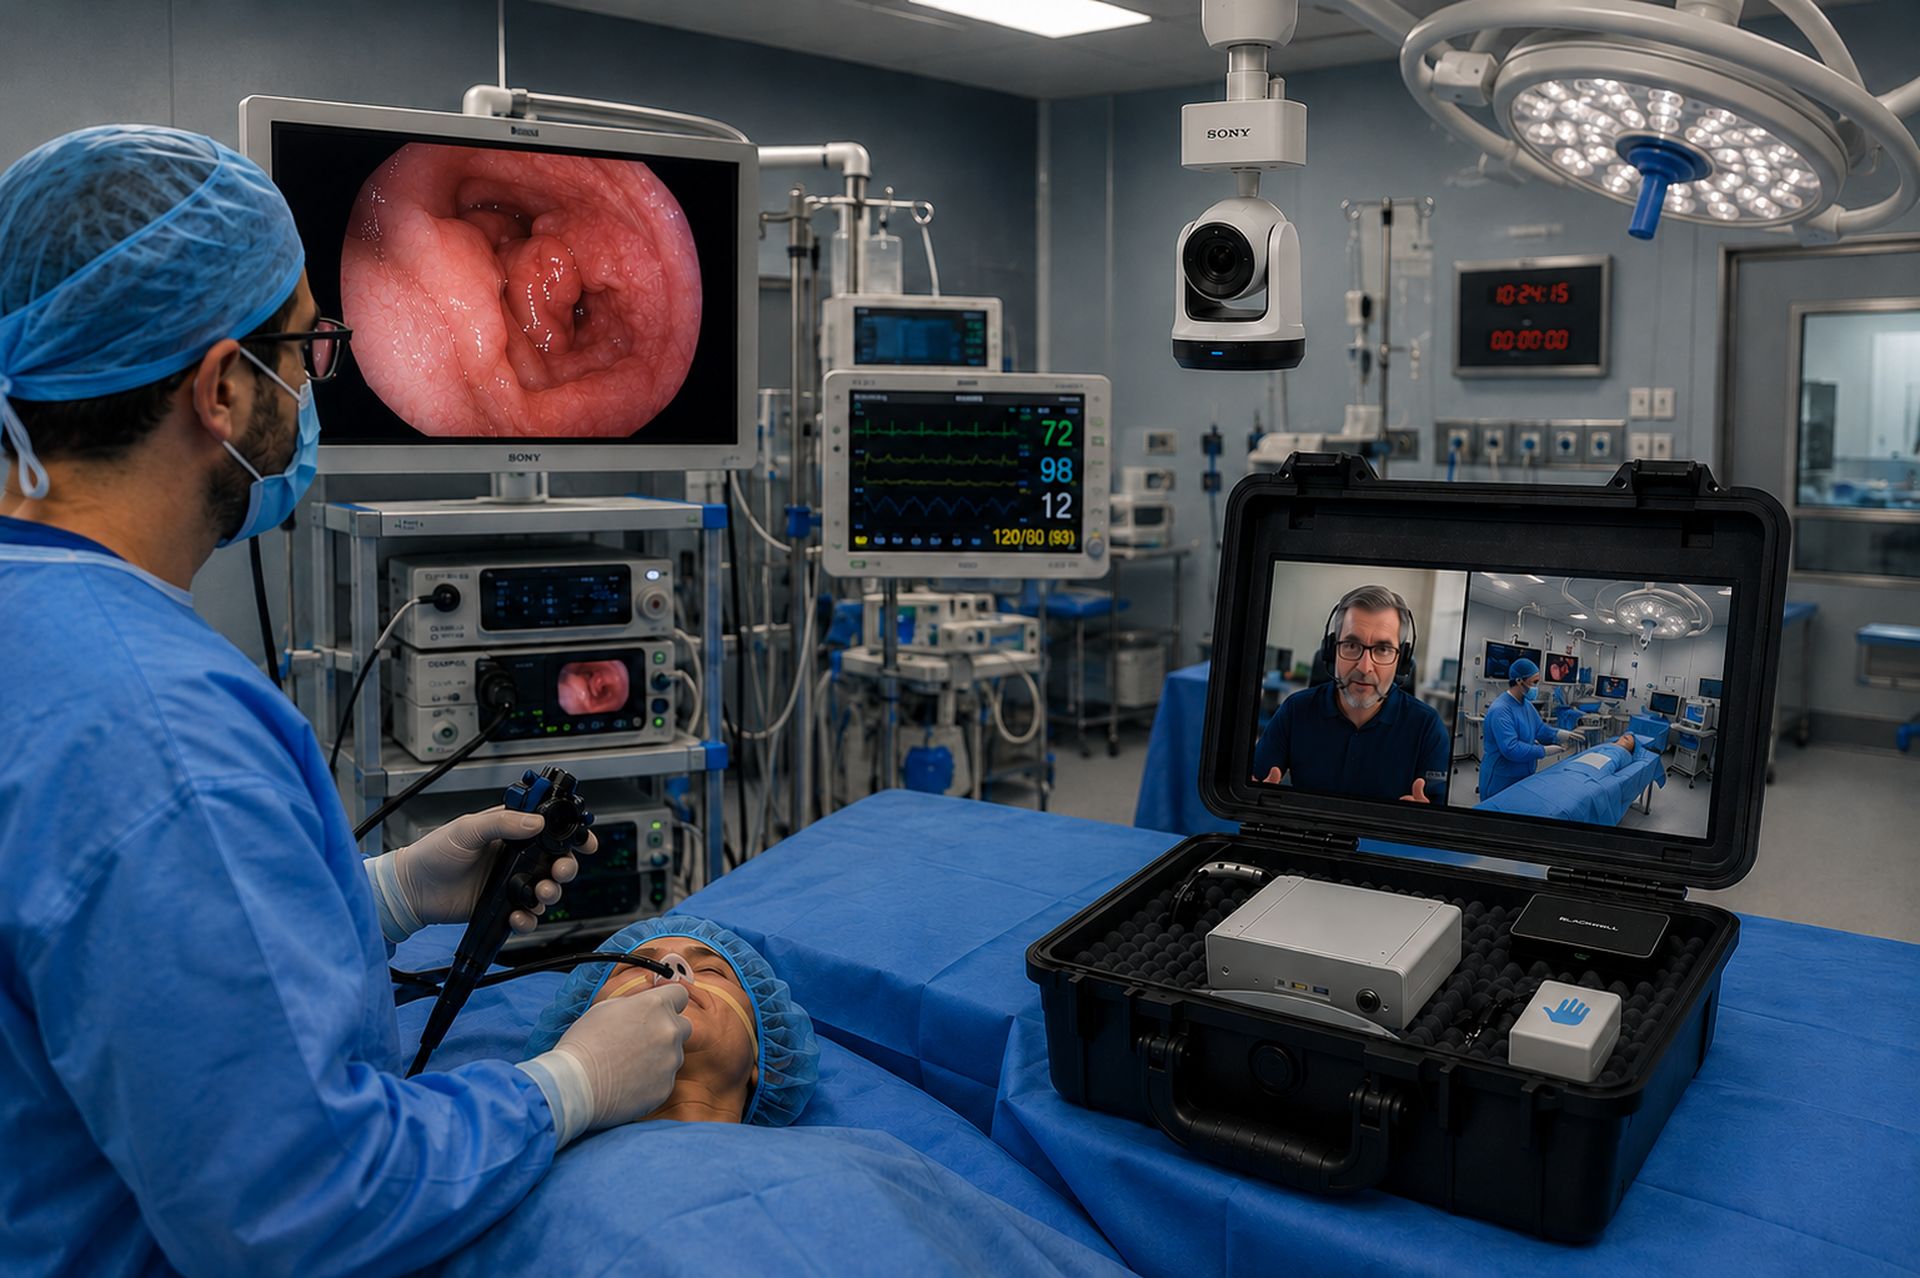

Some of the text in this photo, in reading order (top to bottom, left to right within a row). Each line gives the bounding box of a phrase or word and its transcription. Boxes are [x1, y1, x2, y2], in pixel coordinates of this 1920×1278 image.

[1207, 128, 1250, 139] SONY
[1496, 281, 1568, 305] 10:24:15
[1490, 329, 1569, 350] 00:00:00
[1041, 419, 1073, 447] 72
[508, 453, 541, 462] SONY
[1040, 456, 1073, 483] 98
[1041, 491, 1072, 519] 12
[1048, 529, 1075, 546] (93)
